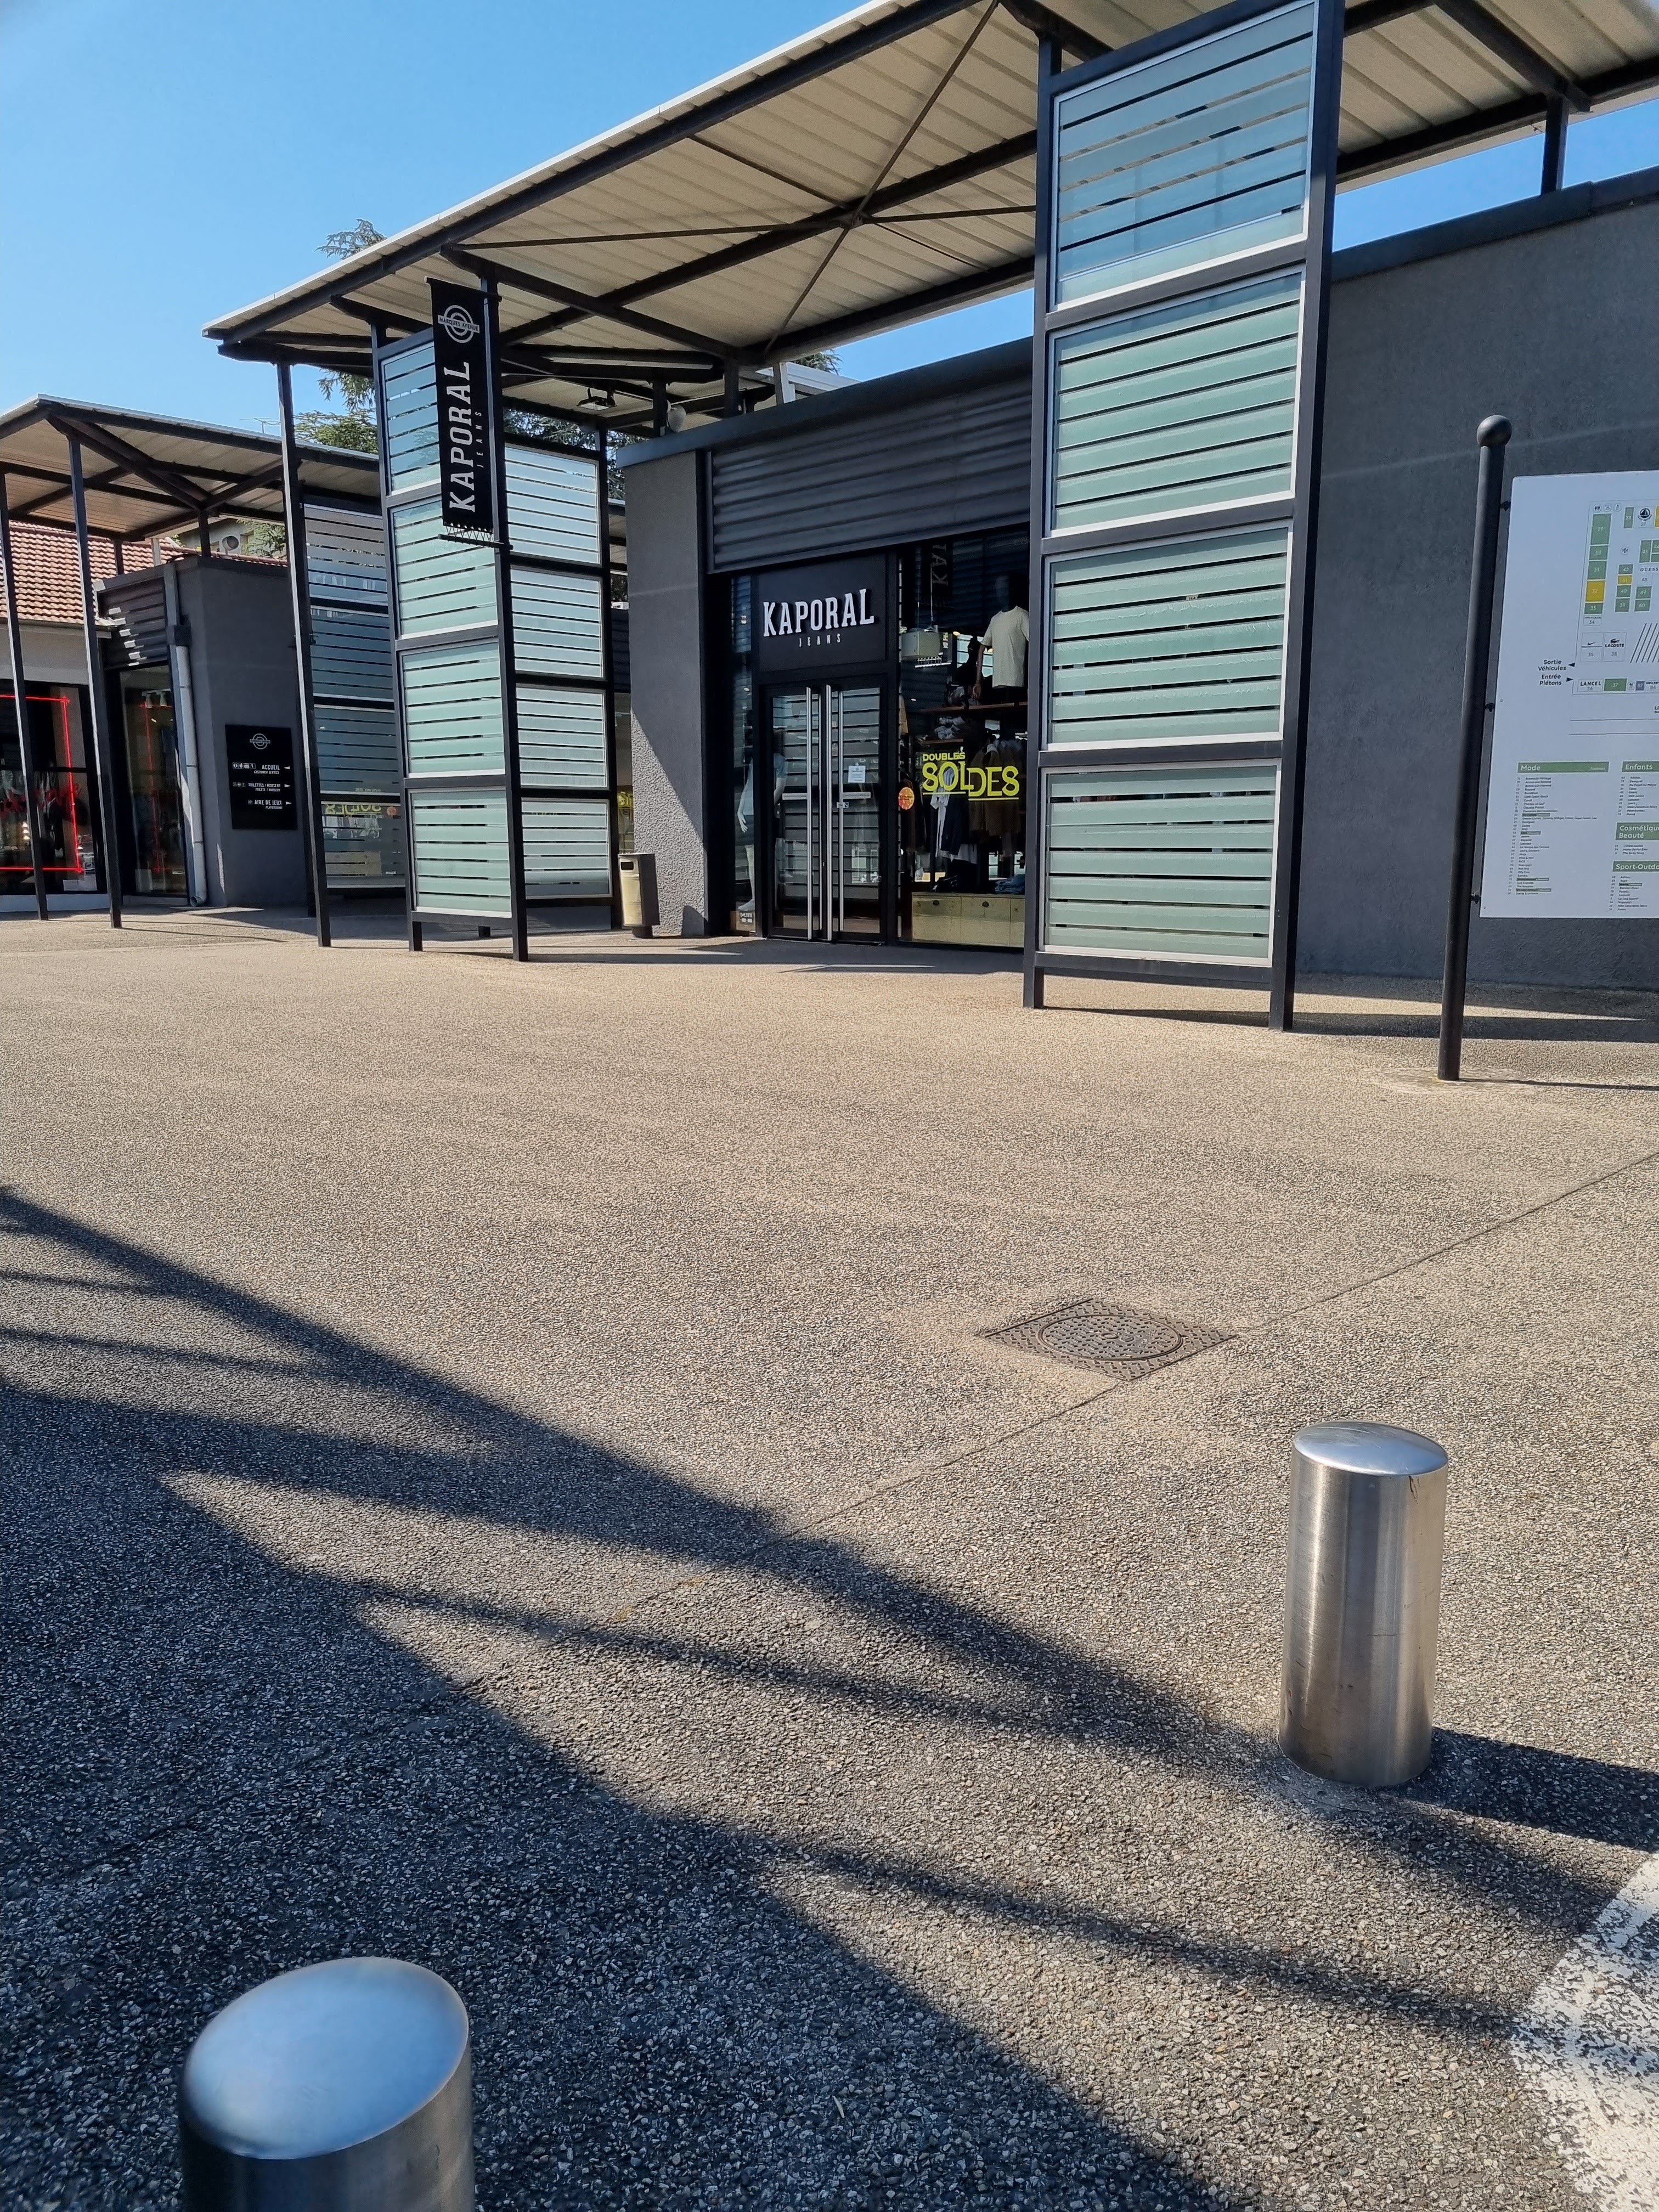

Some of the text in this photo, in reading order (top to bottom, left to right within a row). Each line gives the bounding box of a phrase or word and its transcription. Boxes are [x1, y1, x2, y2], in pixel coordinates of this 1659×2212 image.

[439, 317, 478, 331] MARQUES AVENUE
[444, 361, 476, 512] KAPORAL
[475, 411, 484, 468] JEANS
[763, 588, 874, 637] KAPORAL
[798, 633, 841, 647] JEANS
[922, 752, 966, 761] DOUBLES
[922, 761, 1020, 797] SOLDES
